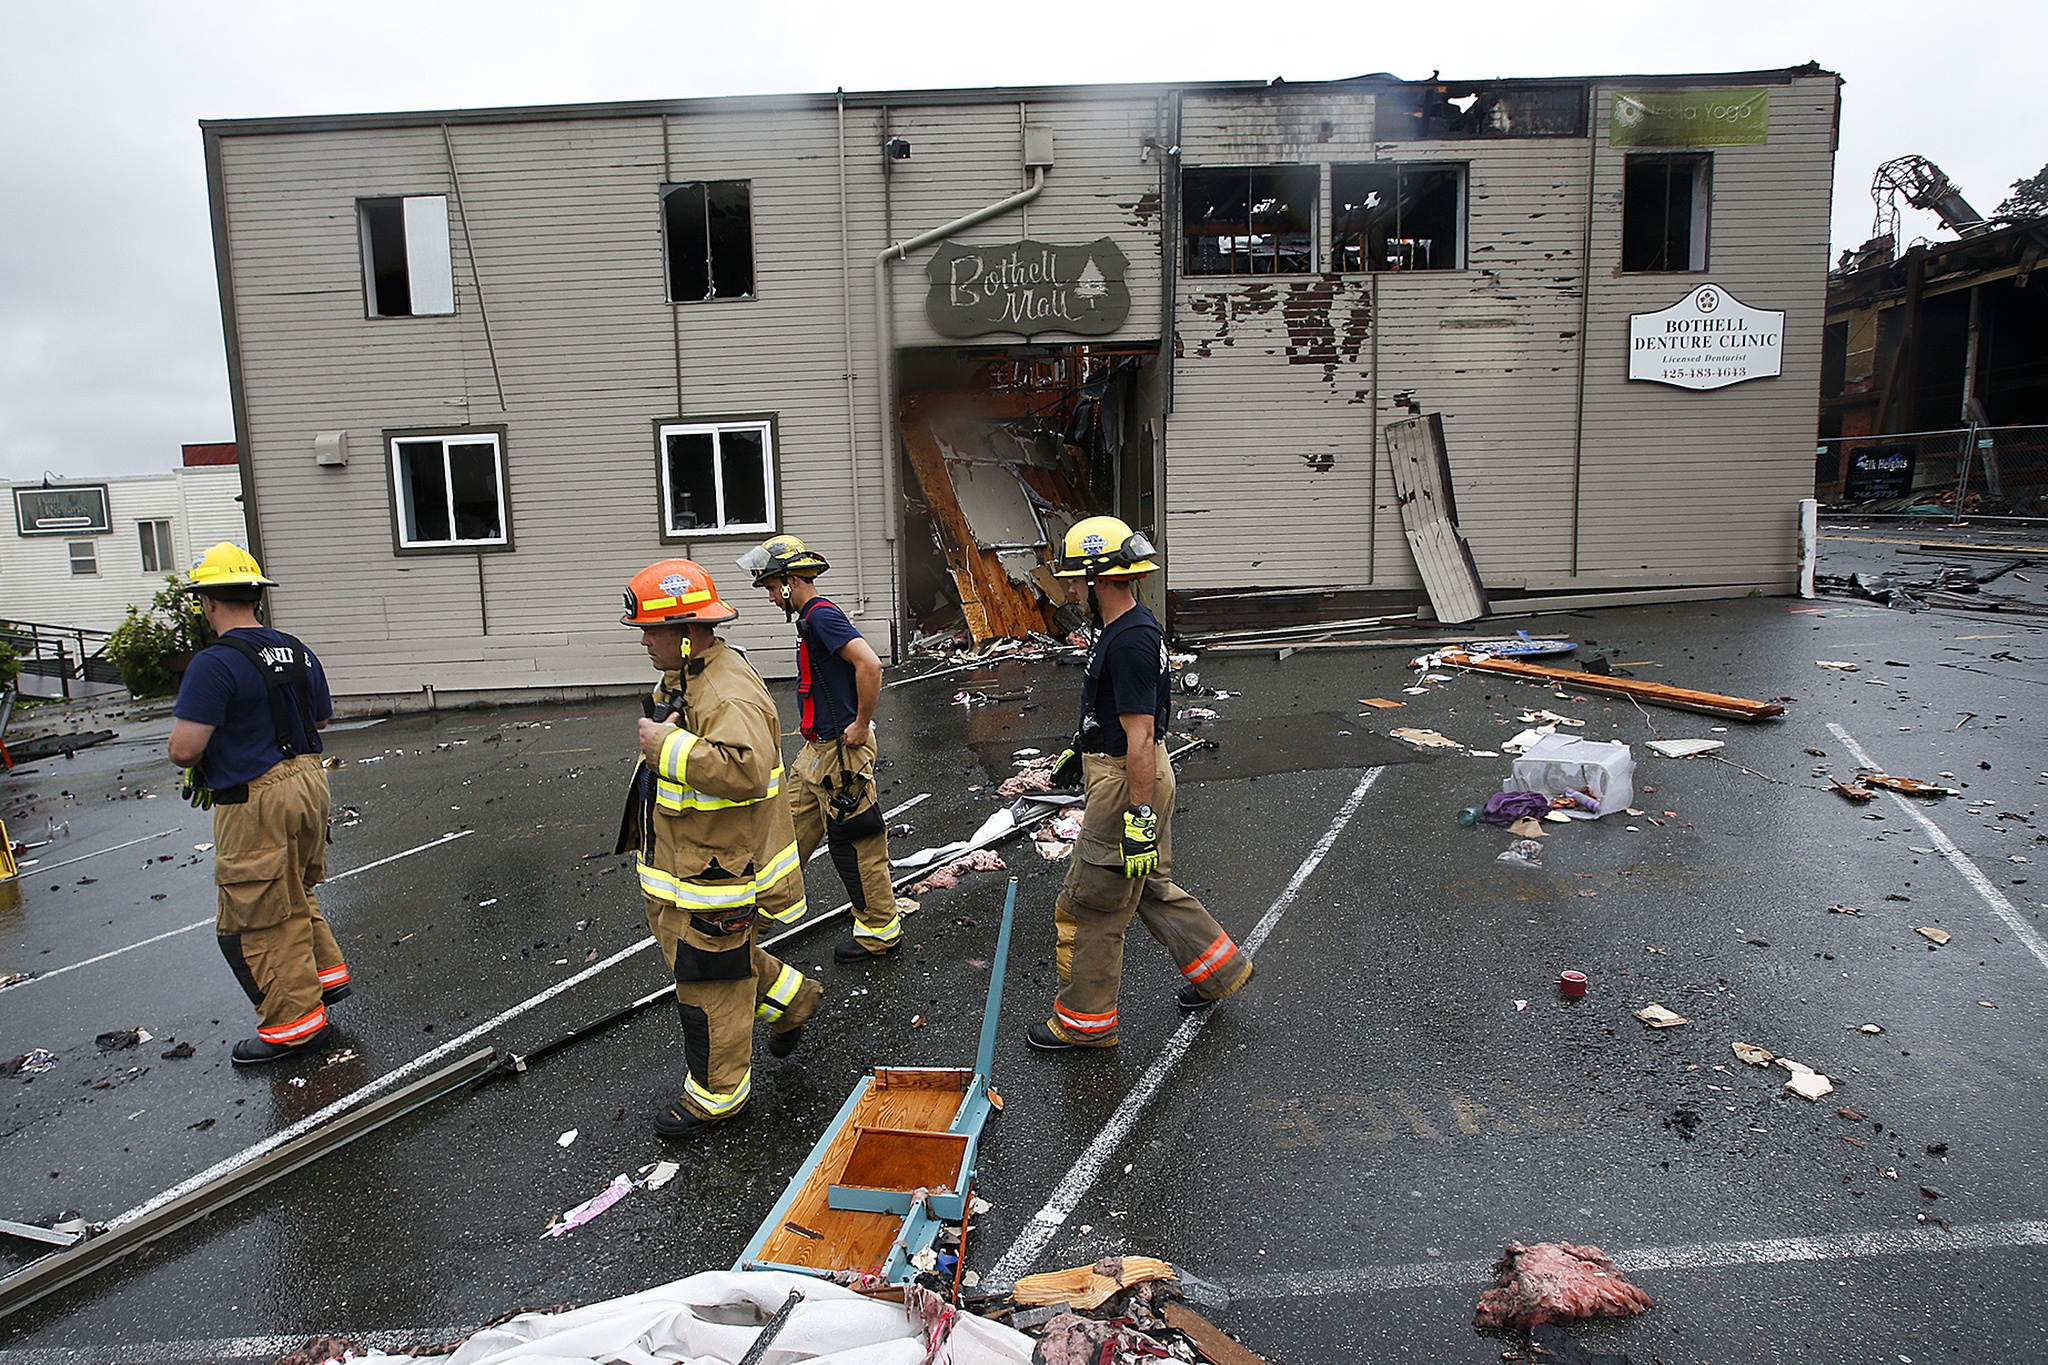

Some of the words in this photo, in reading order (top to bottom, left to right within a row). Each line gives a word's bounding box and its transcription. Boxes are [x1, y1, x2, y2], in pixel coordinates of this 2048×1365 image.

[1705, 102, 1752, 123] Yoga
[950, 249, 1071, 307] Bothell
[986, 288, 1086, 324] Mall
[1665, 318, 1749, 334] BOTHELL
[1634, 335, 1712, 351] DENTURE
[1719, 333, 1778, 348] CLINIC
[1662, 354, 1701, 364] Licensed
[1704, 353, 1747, 363] Denturist
[1661, 366, 1747, 380] 425-483-4643
[1864, 459, 1876, 470] Elk
[1877, 458, 1908, 472] Heights
